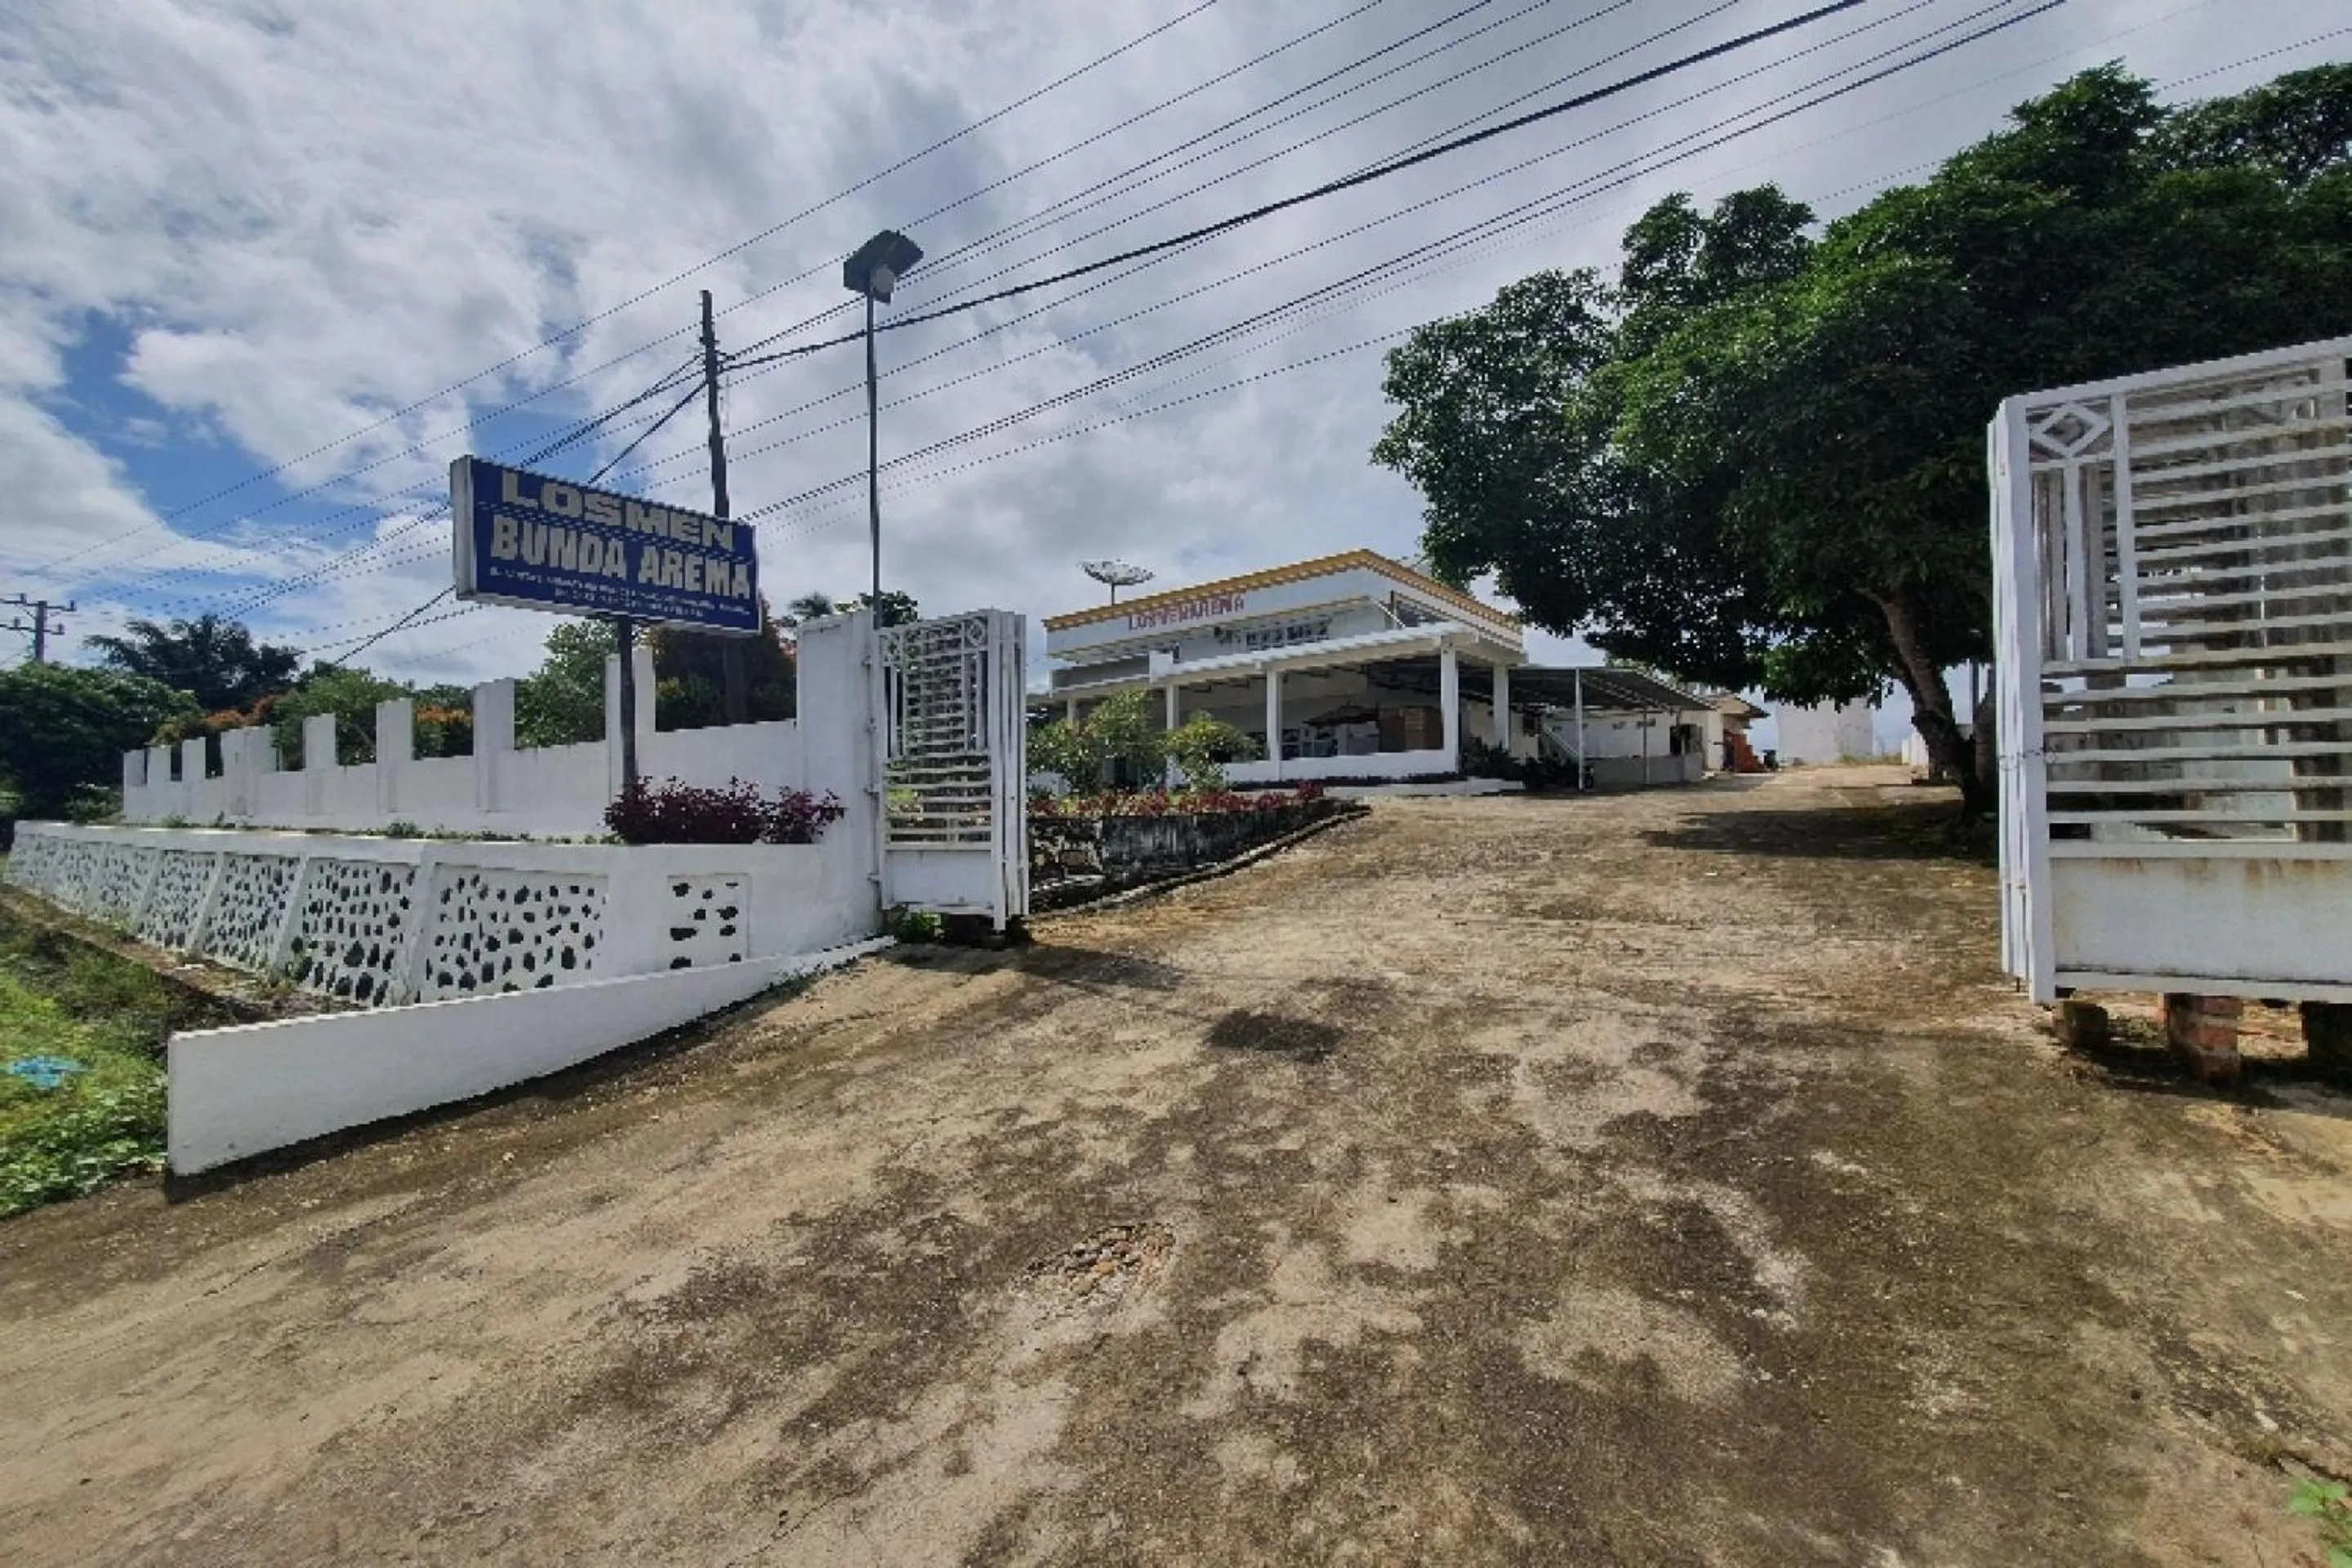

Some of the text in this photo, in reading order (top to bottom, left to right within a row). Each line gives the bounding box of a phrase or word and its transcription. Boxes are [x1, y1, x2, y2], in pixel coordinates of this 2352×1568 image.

[501, 470, 733, 552] LOSMEN
[492, 514, 627, 578] BUNDA
[638, 545, 751, 600] AREMA
